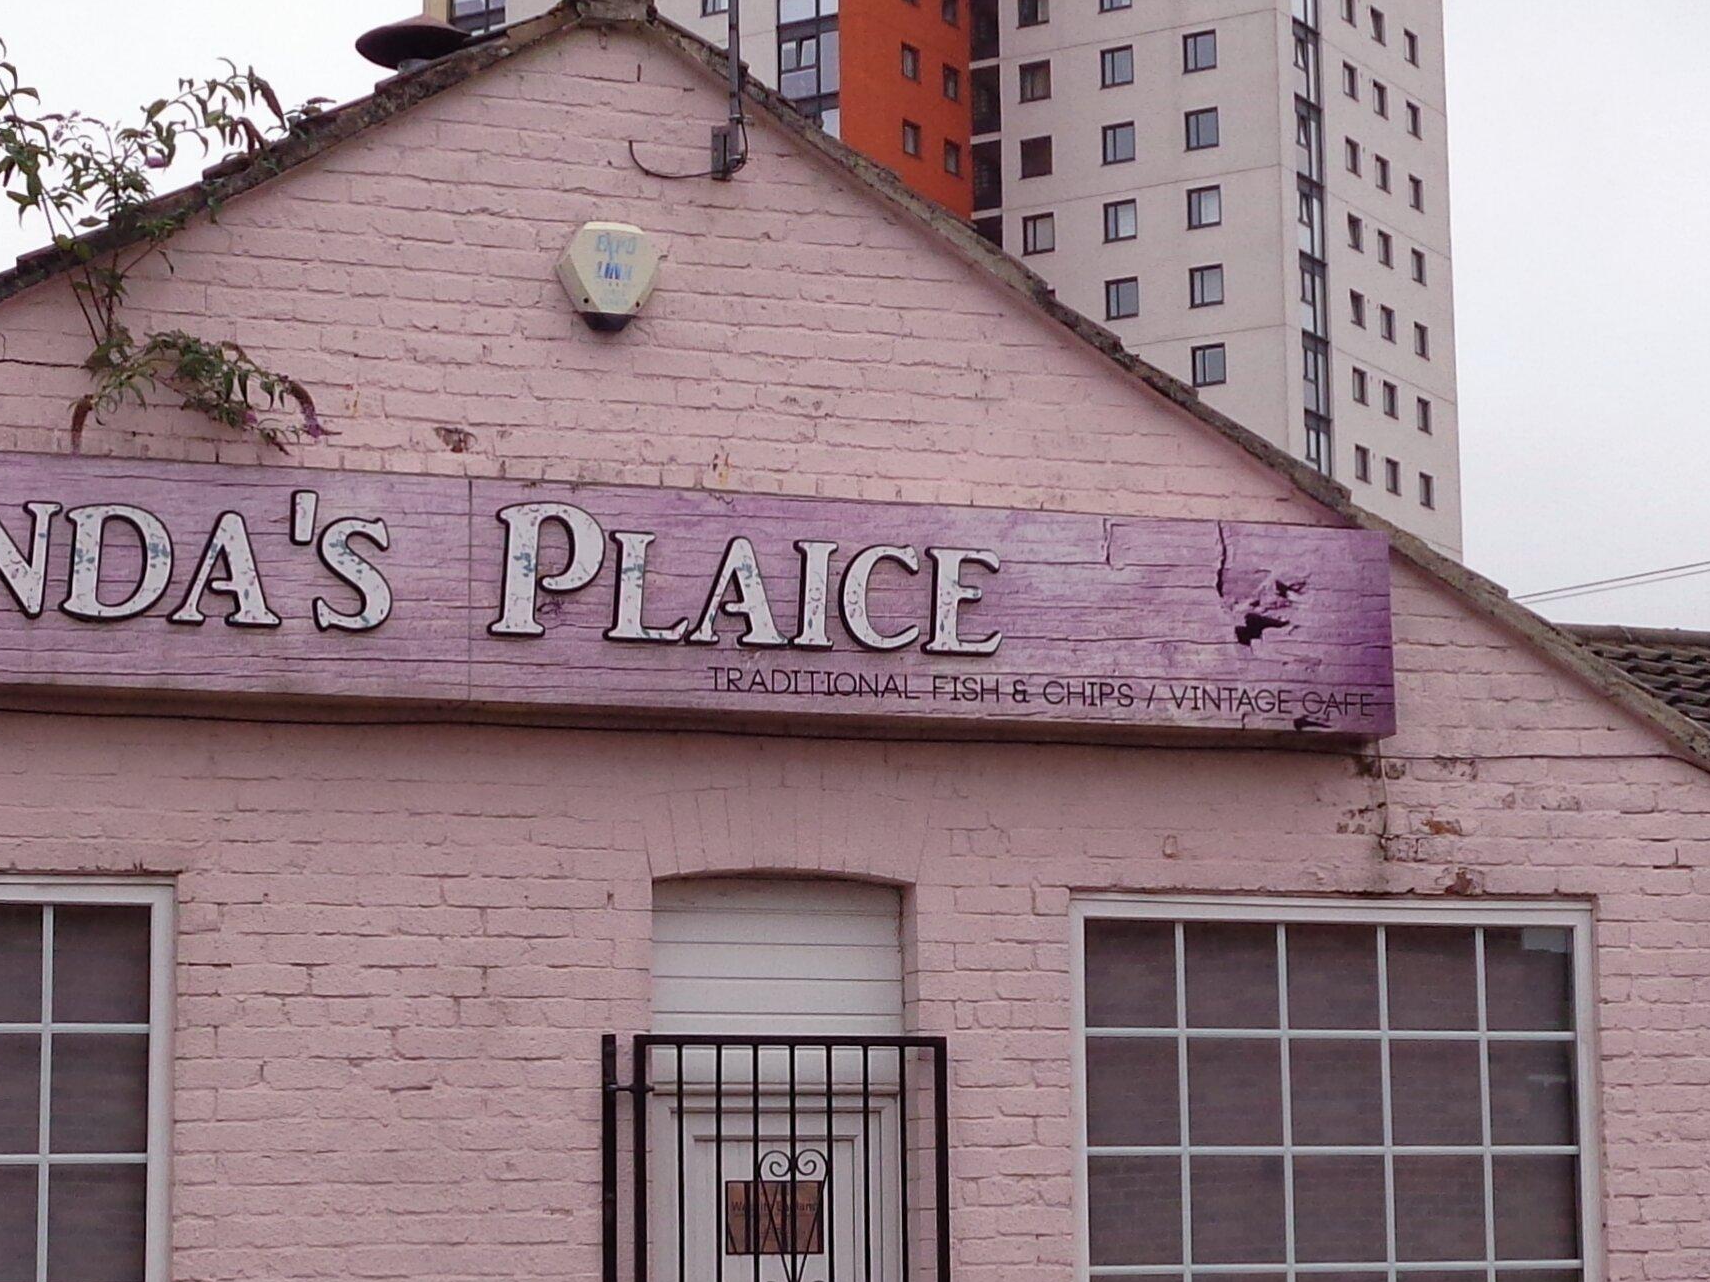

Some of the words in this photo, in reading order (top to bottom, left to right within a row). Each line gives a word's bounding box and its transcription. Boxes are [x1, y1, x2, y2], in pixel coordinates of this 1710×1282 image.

[487, 501, 1002, 656] PLAICE
[707, 667, 921, 700] TRADITIONAL
[932, 675, 1000, 703] FISH
[1011, 679, 1030, 704] &
[1043, 680, 1134, 708] CHIPS
[1145, 684, 1156, 710] /
[1169, 684, 1292, 715] VINTAGE
[1302, 690, 1375, 717] CAFE
